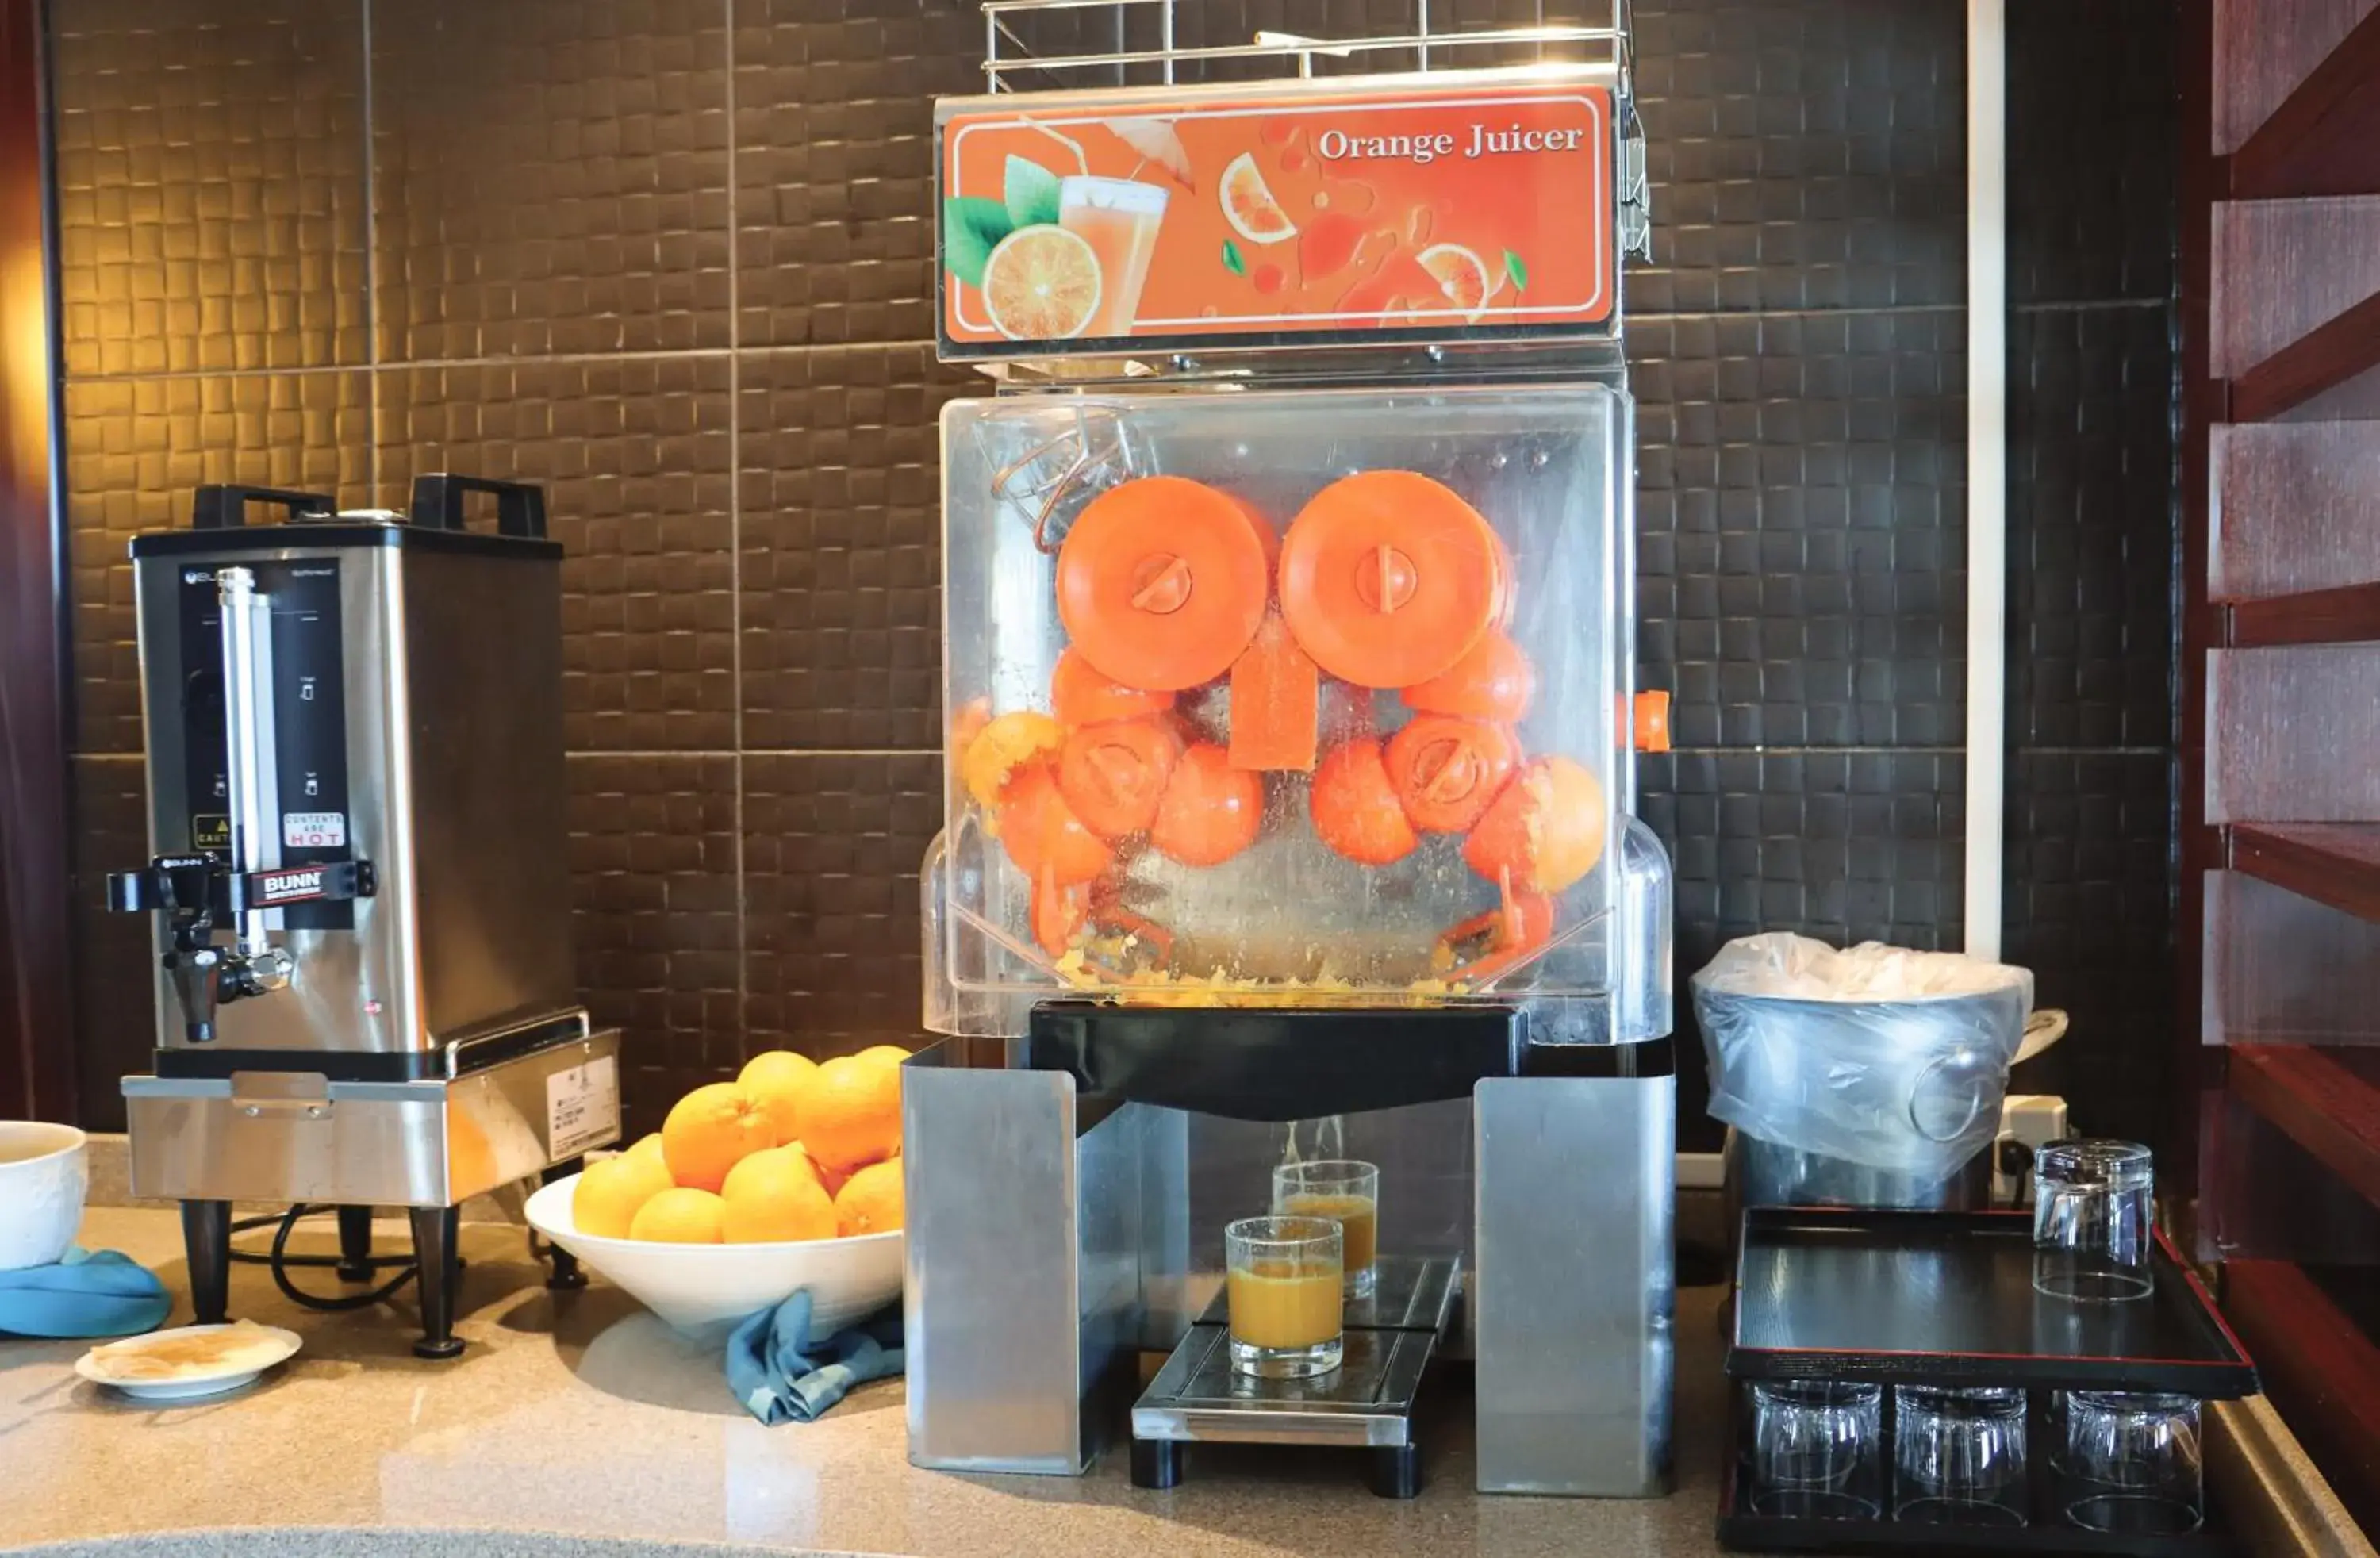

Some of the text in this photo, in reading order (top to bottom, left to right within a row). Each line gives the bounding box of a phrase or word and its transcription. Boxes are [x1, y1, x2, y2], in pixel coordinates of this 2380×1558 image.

[1319, 123, 1583, 163] Orange Juicer
[198, 834, 229, 842] CAUT
[291, 833, 340, 846] HOT
[263, 872, 321, 892] BUNN
